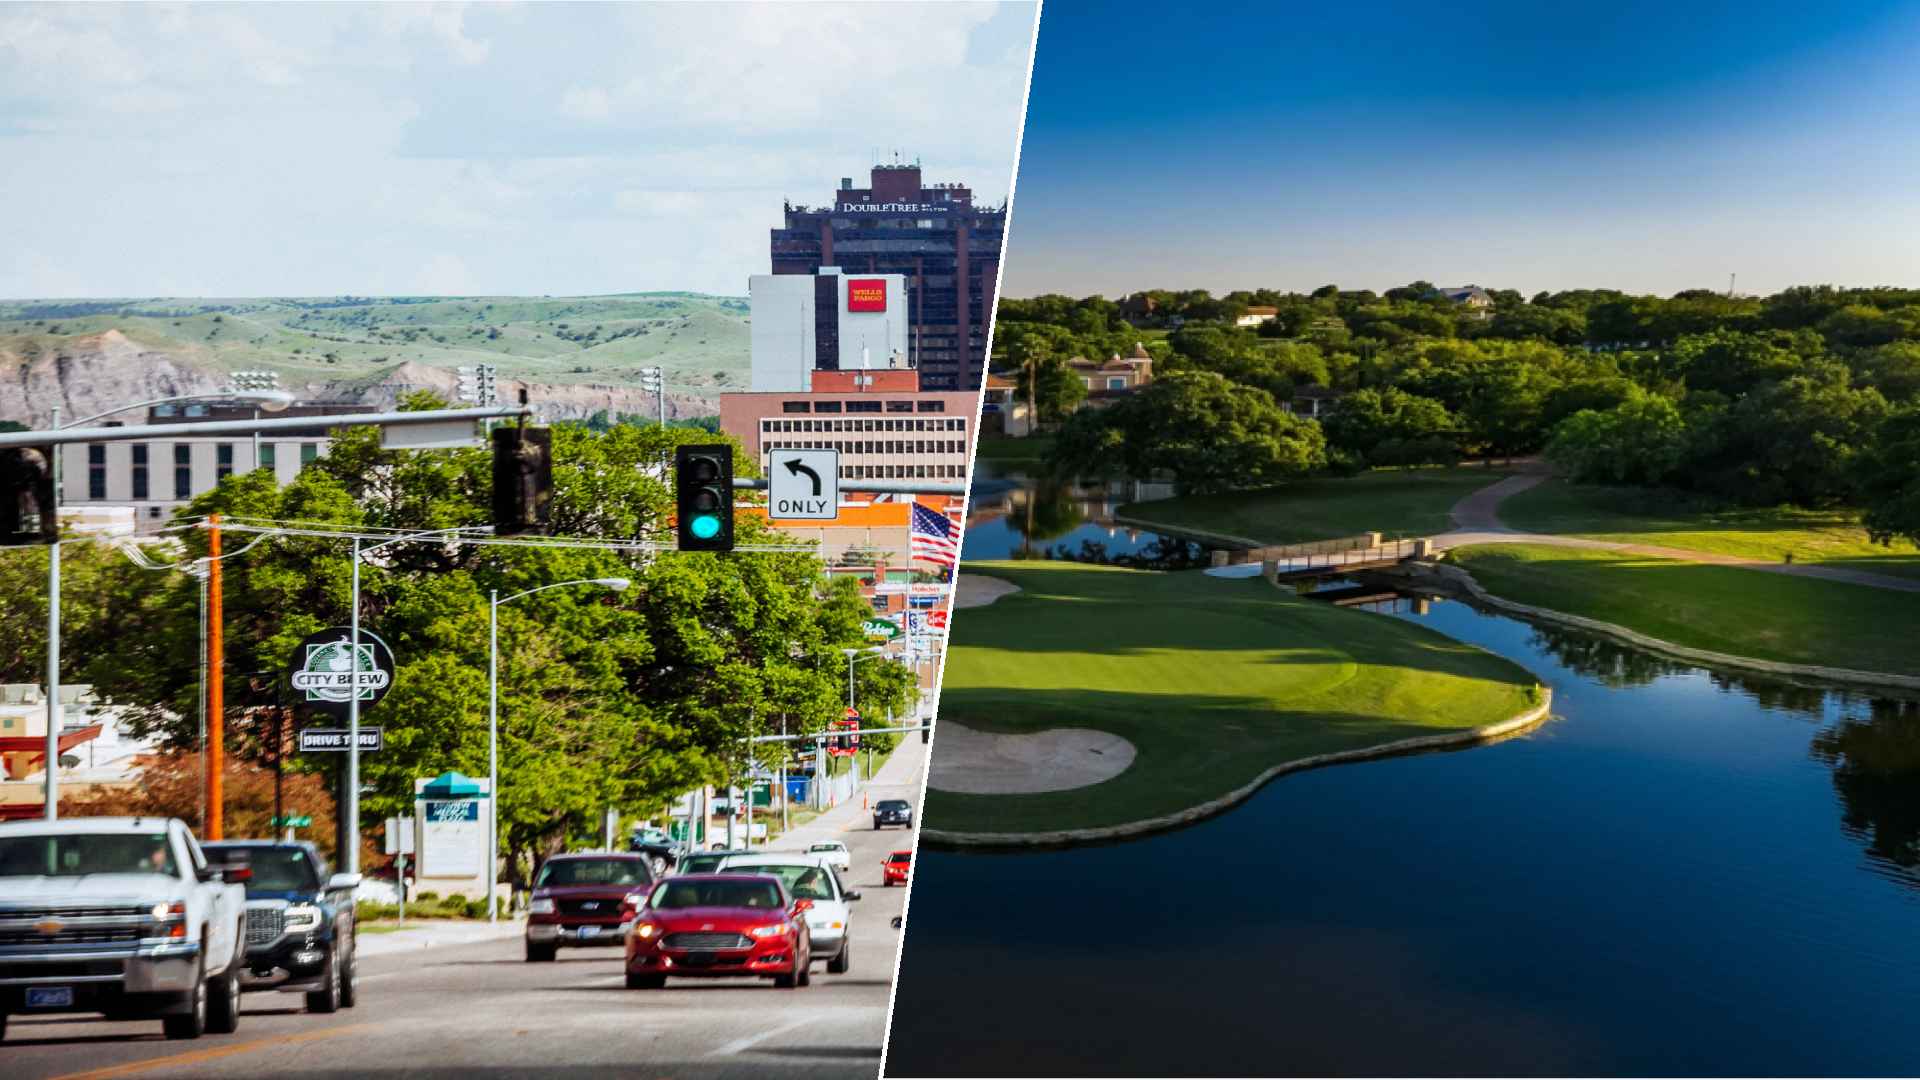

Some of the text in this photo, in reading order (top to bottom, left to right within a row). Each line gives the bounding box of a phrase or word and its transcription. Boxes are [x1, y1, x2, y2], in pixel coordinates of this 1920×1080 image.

[778, 499, 828, 514] ONLY
[296, 674, 332, 685] CITY
[303, 734, 377, 746] DRIVE TRU
